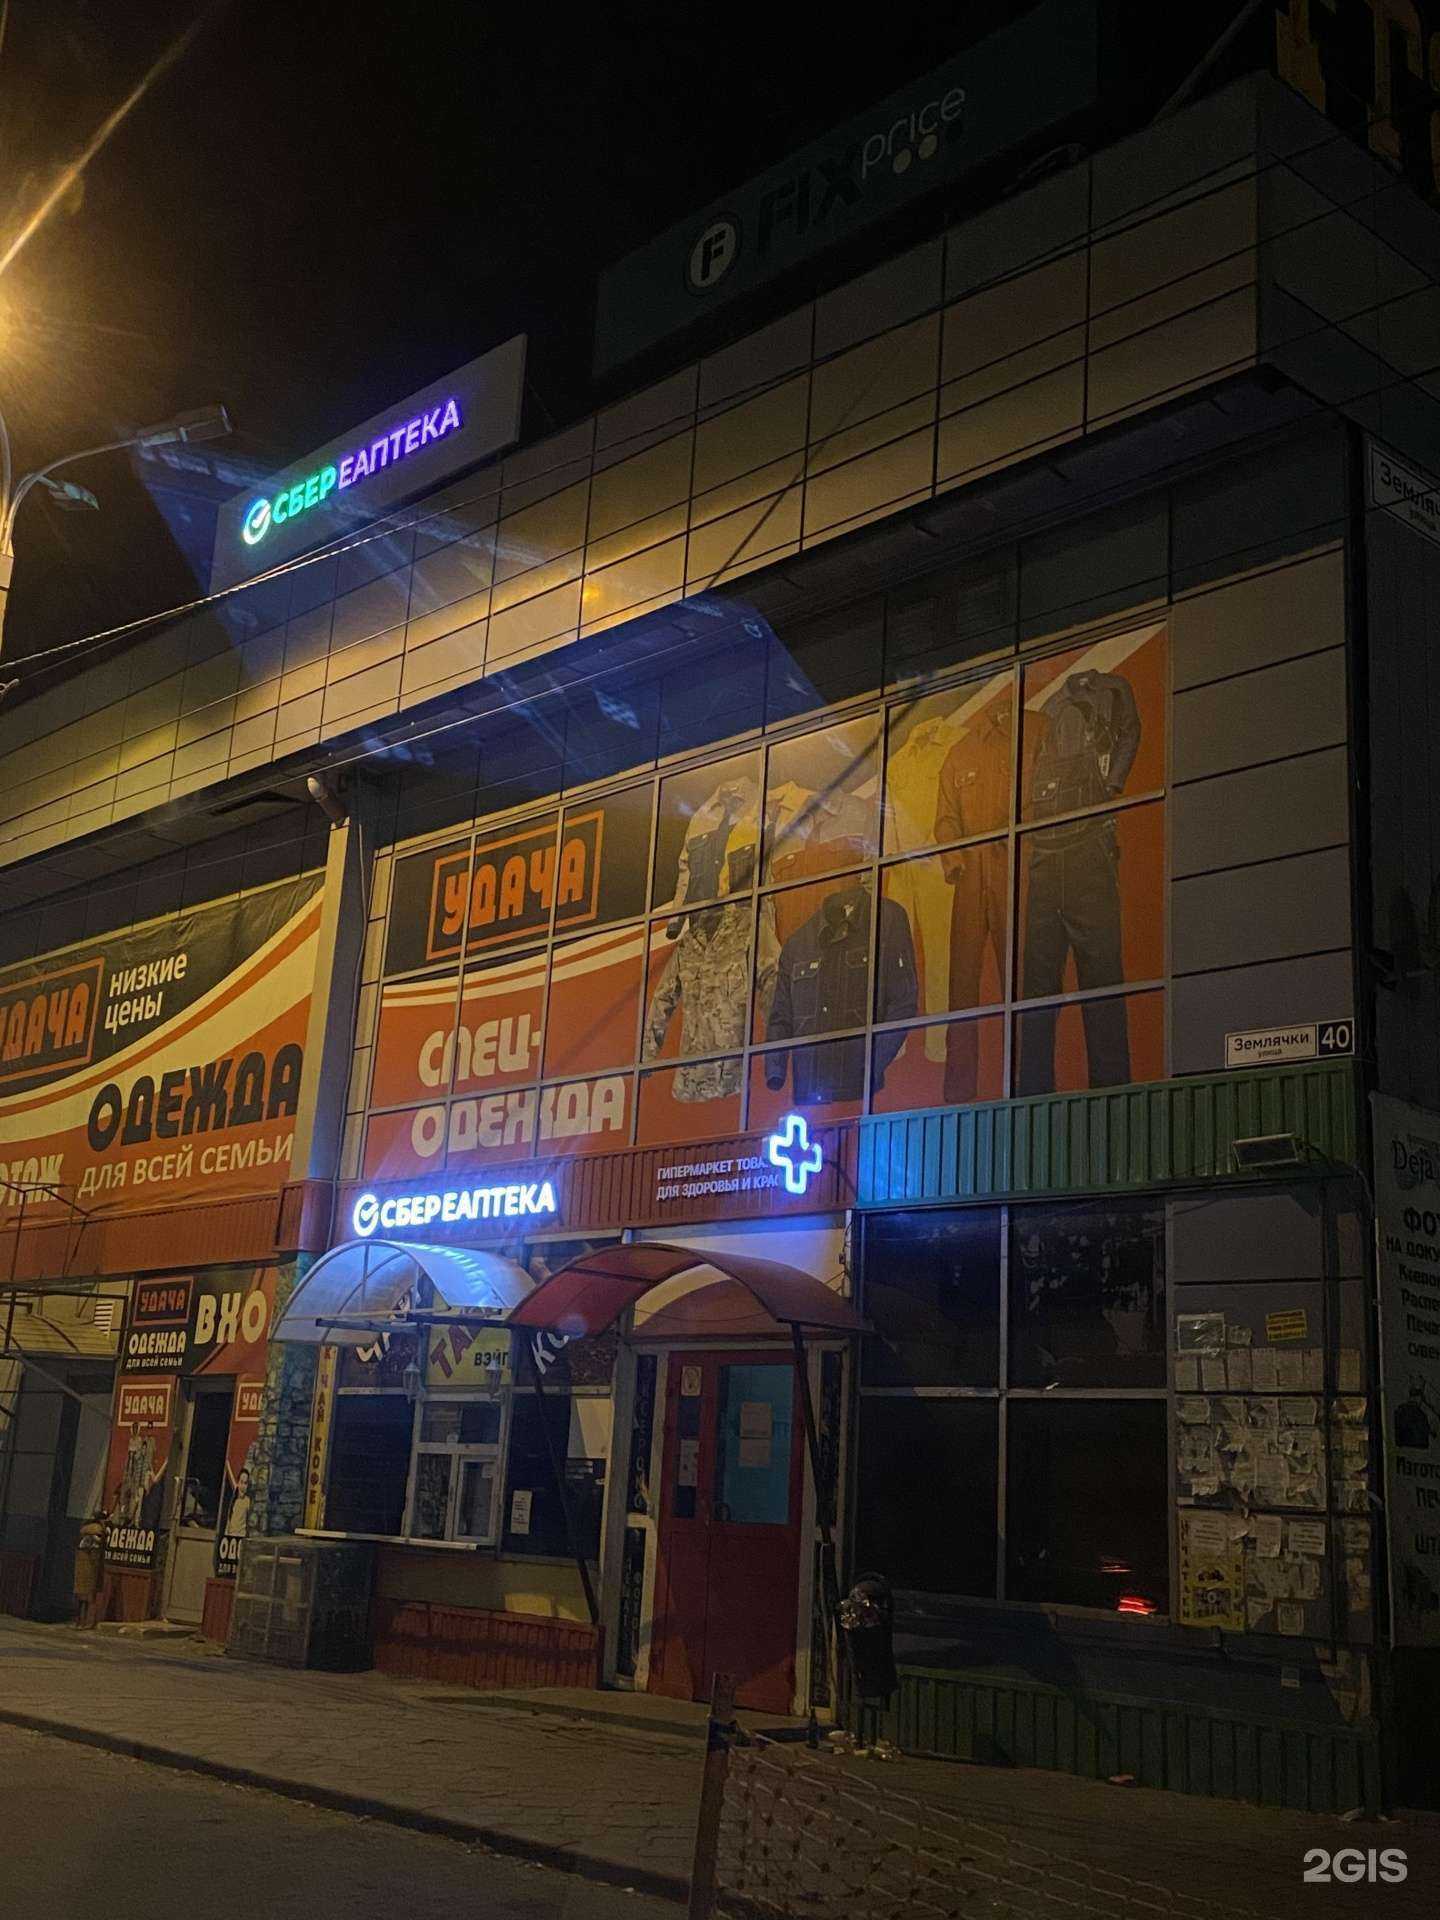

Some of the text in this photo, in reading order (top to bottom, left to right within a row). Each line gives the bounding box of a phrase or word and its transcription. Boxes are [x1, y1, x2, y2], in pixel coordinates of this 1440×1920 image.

[861, 87, 966, 180] price
[442, 838, 586, 936] УДАЧА
[108, 953, 188, 998] низкие
[104, 992, 163, 1034] цены
[417, 1013, 541, 1088] СПЕЦ-
[1233, 1032, 1310, 1052] Землячки
[1320, 1024, 1350, 1050] 40
[88, 1044, 304, 1152] ОДЕЖДА
[411, 1075, 626, 1158] ОДЕЖДА
[78, 1132, 294, 1198] ДЛЯ ВСЕЙ СЕМЬИ
[657, 1160, 733, 1180] ГИПЕРМАРКЕТ
[656, 1186, 680, 1201] ДЛЯ
[681, 1178, 739, 1198] ЗДОРОВЬЯ
[741, 1177, 752, 1190] И
[1403, 1207, 1440, 1238] ФО
[140, 1288, 186, 1313] УДАЧА
[128, 1330, 187, 1356] ОДЕЖДА
[124, 1395, 165, 1415] УДАЧА
